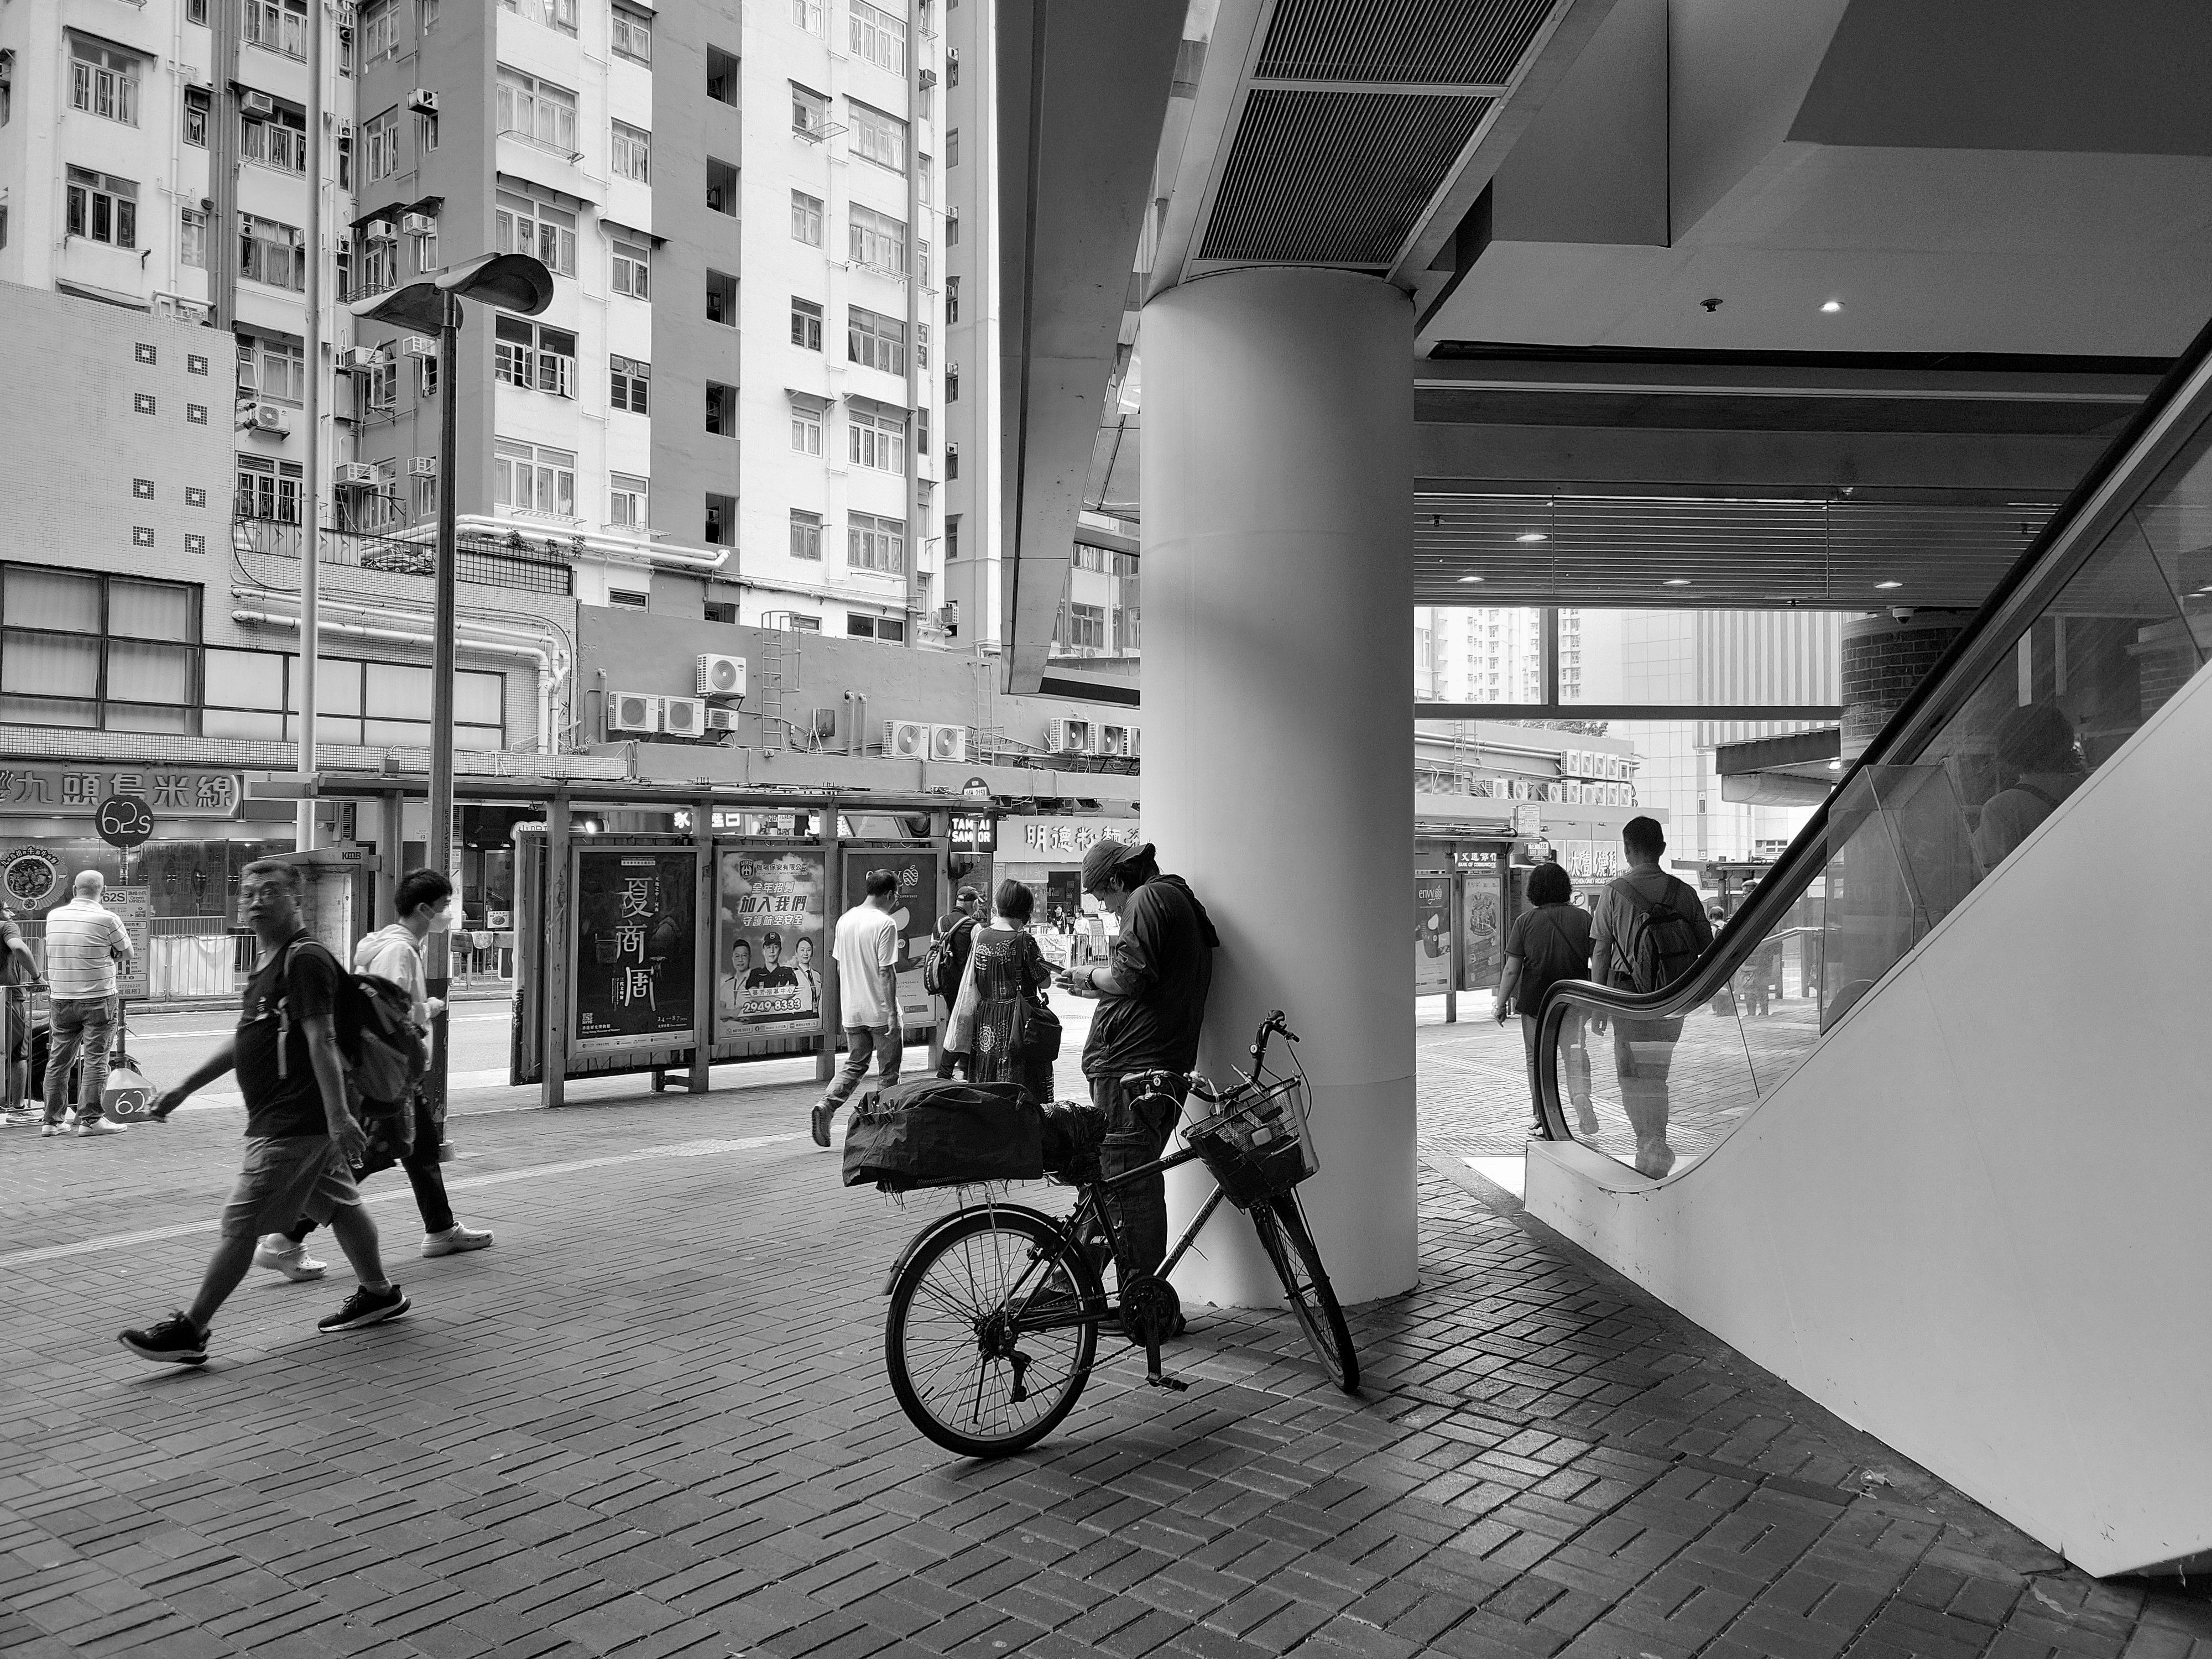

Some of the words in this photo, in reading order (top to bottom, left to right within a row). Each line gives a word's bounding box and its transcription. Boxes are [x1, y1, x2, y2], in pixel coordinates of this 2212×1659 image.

[952, 818, 990, 830] TAMAI
[952, 831, 990, 842] SAMOR
[342, 852, 362, 860] KMB
[103, 893, 125, 902] 62S
[1419, 889, 1435, 905] envy
[738, 895, 808, 913] 加入我們
